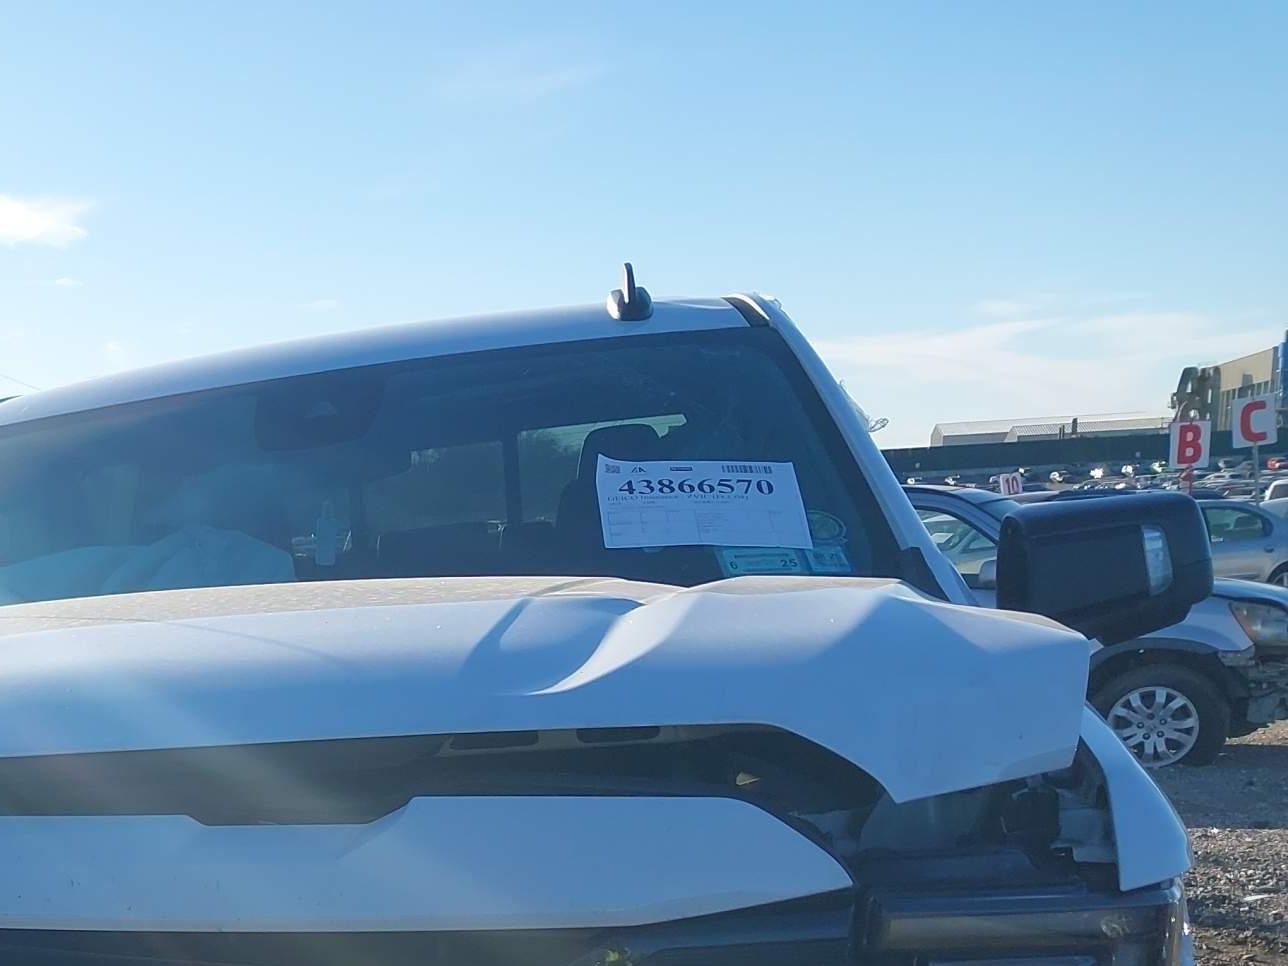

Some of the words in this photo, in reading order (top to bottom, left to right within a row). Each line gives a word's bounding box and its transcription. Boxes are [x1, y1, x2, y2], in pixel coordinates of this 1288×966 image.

[1240, 400, 1268, 442] C
[1177, 423, 1202, 465] B
[618, 478, 774, 495] 43866570
[780, 559, 798, 568] 25
